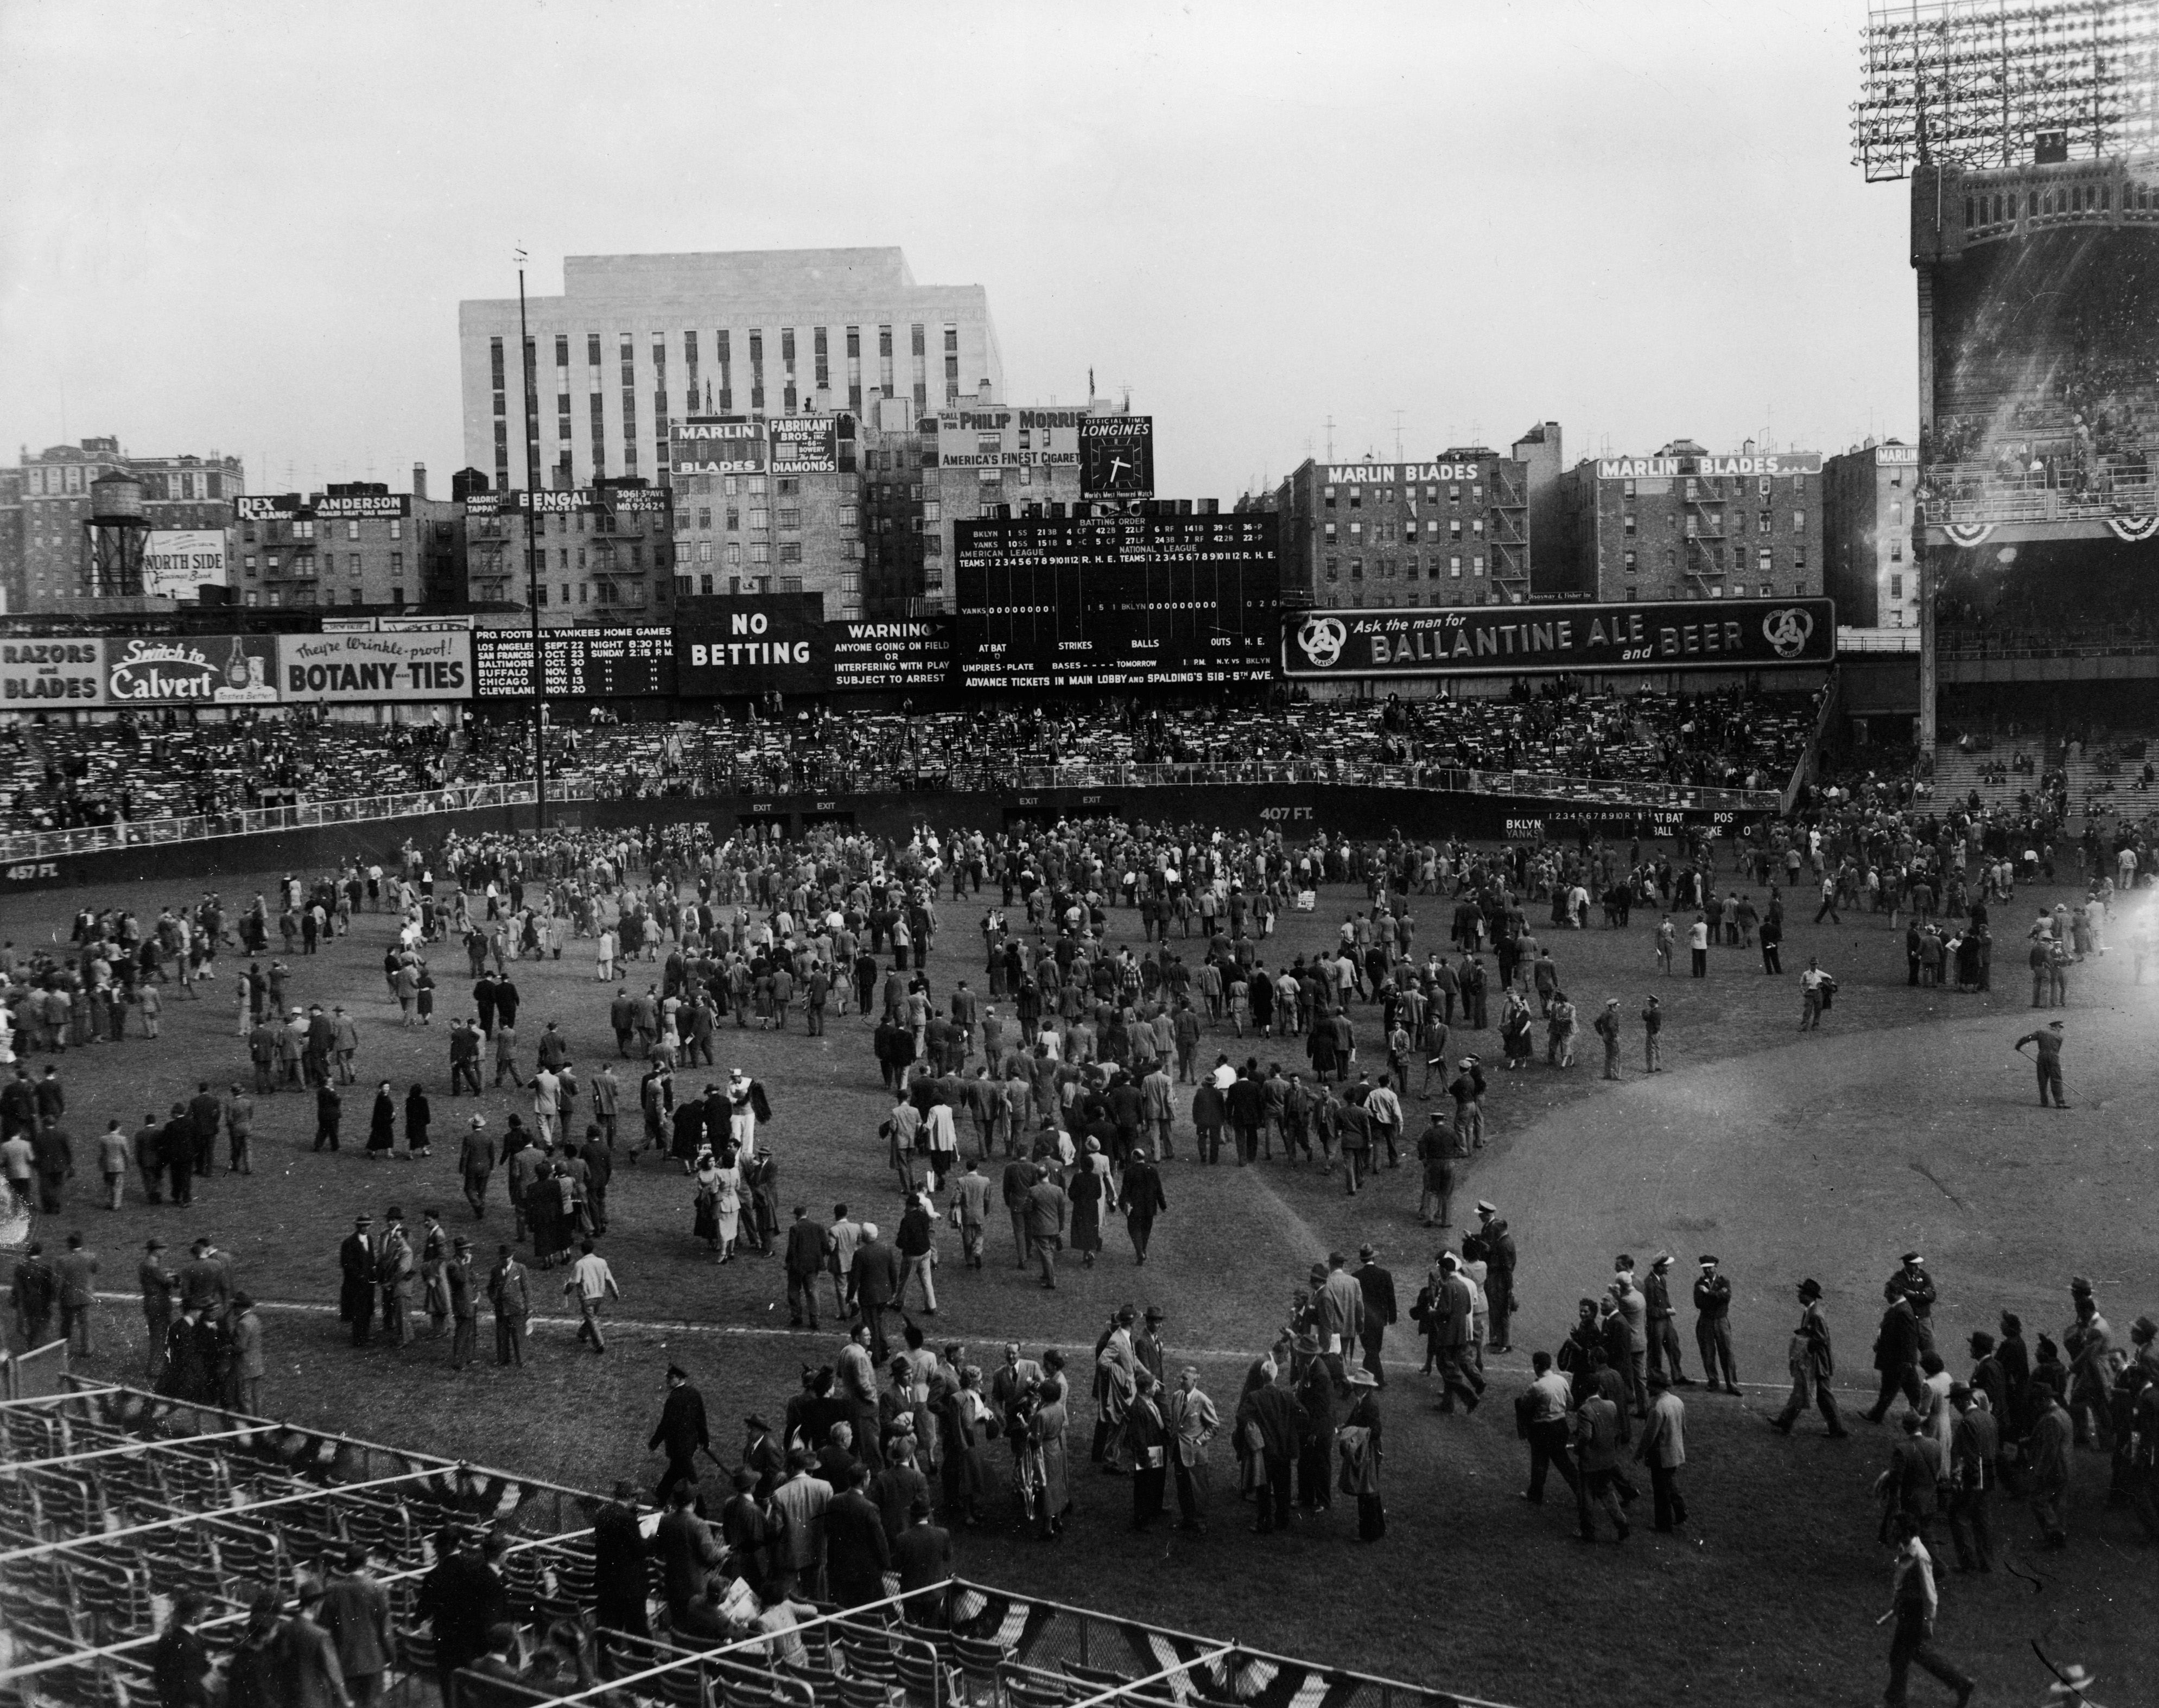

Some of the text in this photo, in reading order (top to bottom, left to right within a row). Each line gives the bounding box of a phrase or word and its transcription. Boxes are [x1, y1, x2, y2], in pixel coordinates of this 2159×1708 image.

[771, 419, 834, 433] FABRIKANT
[960, 411, 1011, 430] PHILIP
[679, 426, 755, 439] MARLIN
[780, 431, 826, 441] BROS. INC.
[1081, 423, 1150, 437] LONGINES
[943, 452, 1080, 466] AMERICA'S FINEST CIGARET
[1878, 448, 1917, 463] MARLIN
[681, 461, 755, 472] BLADES
[772, 461, 835, 473] DIAMONDS
[1329, 463, 1478, 483] MARLIN BLADES
[1602, 456, 1779, 477] MARLIN BLADES
[318, 497, 401, 510] ANDERSON
[467, 496, 498, 504] CALORIC
[519, 491, 592, 507] BENGAL
[238, 497, 275, 522] REX
[1080, 517, 1146, 526] BATTING ORDER
[1010, 548, 1044, 556] LEAGUE
[1119, 545, 1157, 554] NATIONAL
[1164, 544, 1197, 553] LEAGUE
[193, 554, 223, 569] SIDE
[959, 554, 1146, 567] TEAMS TEAMS
[732, 613, 767, 635] NO
[1353, 613, 1466, 633] Ask the man for
[476, 627, 672, 639] PRO. FOOTBLL YANKEES HOME GAMES
[1370, 614, 1744, 665] BALLANTINE ALE and BEER
[295, 642, 340, 659] They're
[478, 640, 653, 651] LOS ANGELES SEPT. 22 NIGHT 8:30
[834, 642, 949, 652] ANYONE GOING ON FIELD
[979, 637, 1231, 652] AT BAT STRIKES BALLS OUTS
[4, 644, 96, 664] RAZORS
[123, 639, 205, 664] Switch to
[478, 652, 494, 660] SAN
[544, 650, 566, 658] OCT.
[571, 650, 584, 658] 23
[591, 649, 625, 658] SUNDAY
[629, 649, 651, 657] 2:15
[691, 642, 810, 666] BETTING
[478, 658, 585, 669] BALTIMORE OCT. 30
[834, 661, 949, 672] INTERFERING WITH PLAY
[1052, 662, 1081, 670] BASES
[289, 661, 465, 692] BOTANY TIES
[478, 667, 582, 677] BUFFALO NOV. 6
[966, 677, 1007, 687] ADVANCE
[1011, 677, 1050, 687] TICKETS
[1055, 676, 1064, 685] IN
[1069, 675, 1093, 685] MAIN
[1097, 674, 1127, 684] LOBBY
[1147, 672, 1203, 683] SPALDING'S
[1250, 670, 1274, 680] AVE.
[110, 668, 212, 699] Calvert
[479, 676, 583, 686] CHICAGO NOV. 13
[836, 674, 945, 685] SUBJECT TO ARREST
[5, 677, 97, 699] BLADES
[545, 685, 568, 694] NOV.
[572, 685, 586, 694] 20
[1083, 796, 1101, 804] EXIT
[1260, 807, 1290, 821] 407
[1666, 812, 1684, 823] BAT
[1506, 819, 1541, 829] BKLYN
[1507, 829, 1539, 839] YANKS
